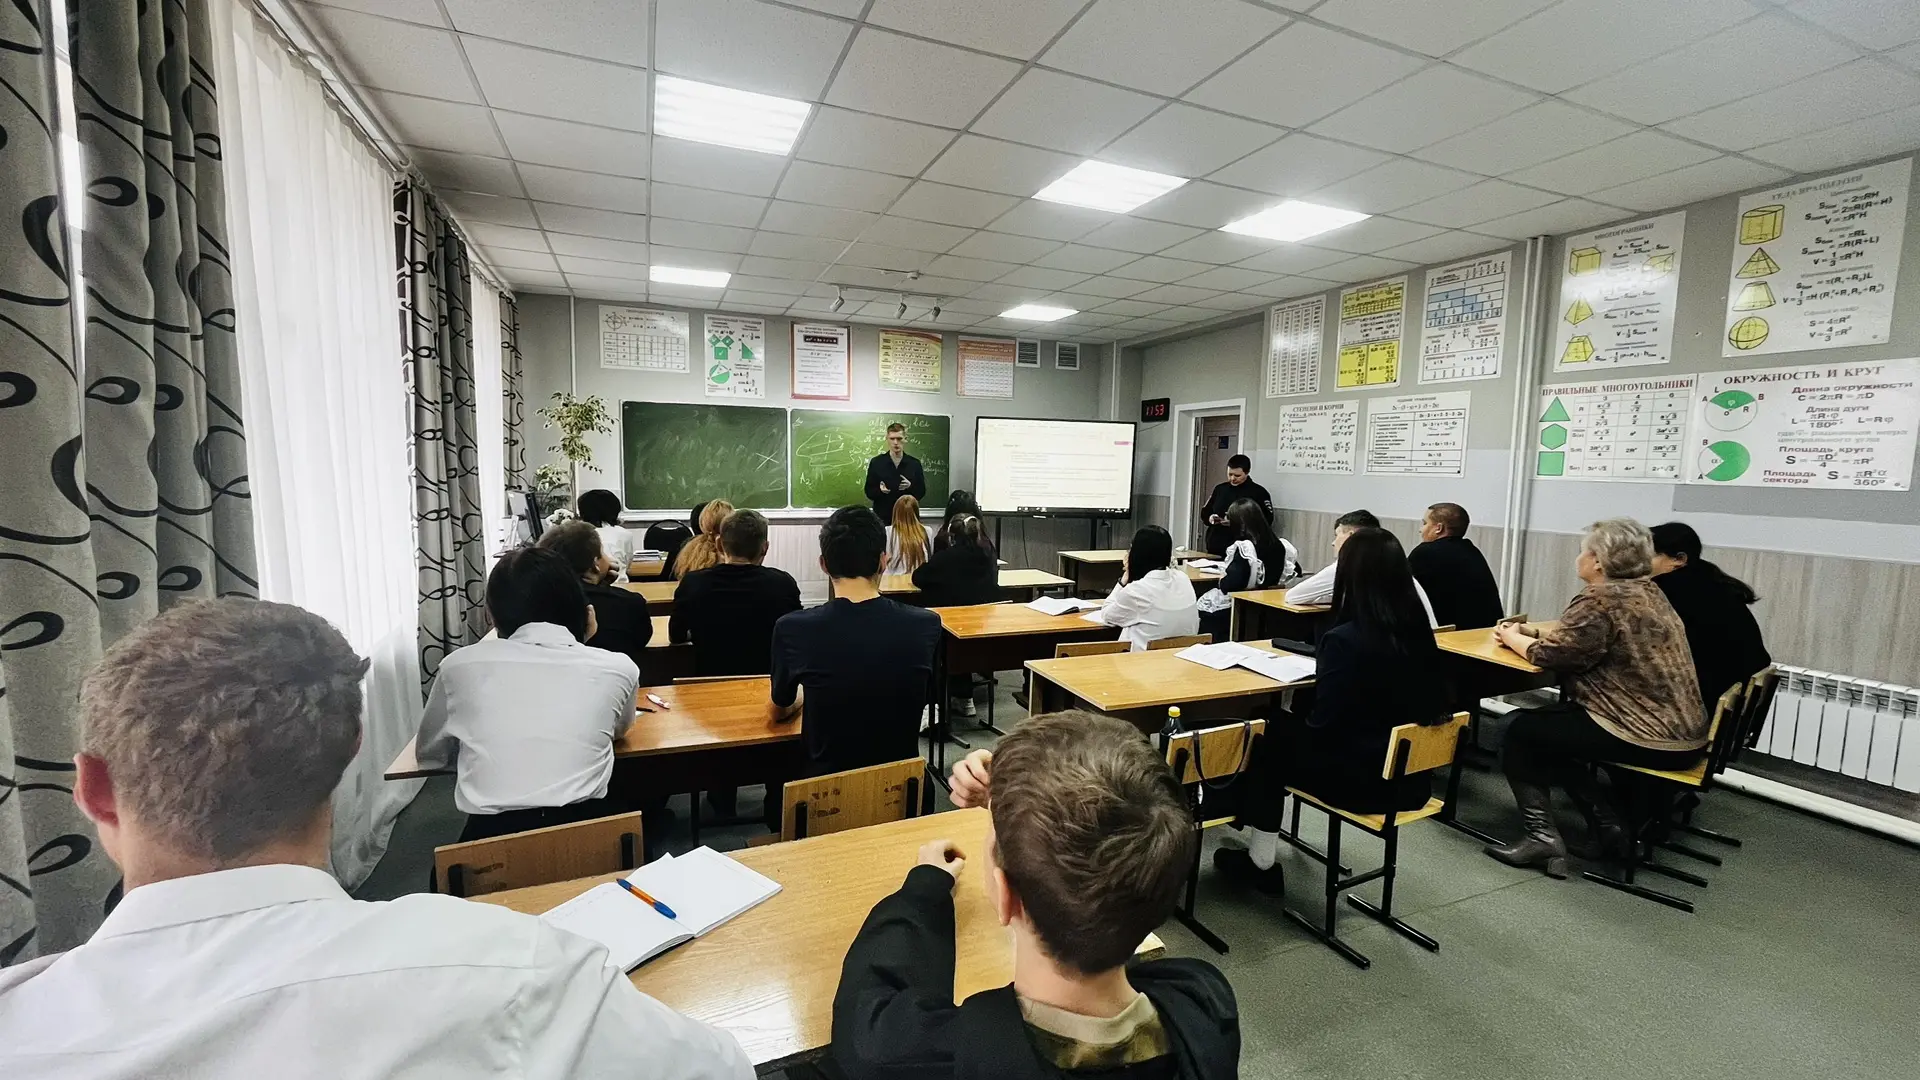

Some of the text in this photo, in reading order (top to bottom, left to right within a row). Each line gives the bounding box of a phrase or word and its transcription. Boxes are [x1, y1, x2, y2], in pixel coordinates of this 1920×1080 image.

[1723, 365, 1885, 385] ОКРУЖНОСТЬ И КРУГ
[1542, 379, 1693, 396] ПРАВИЛЬНЫЕ МНОГОУГОЛЬНИКИ
[1792, 382, 1913, 394] Длина окружности
[1843, 405, 1870, 413] дуги
[1785, 455, 1796, 465] S
[1827, 471, 1839, 480] S
